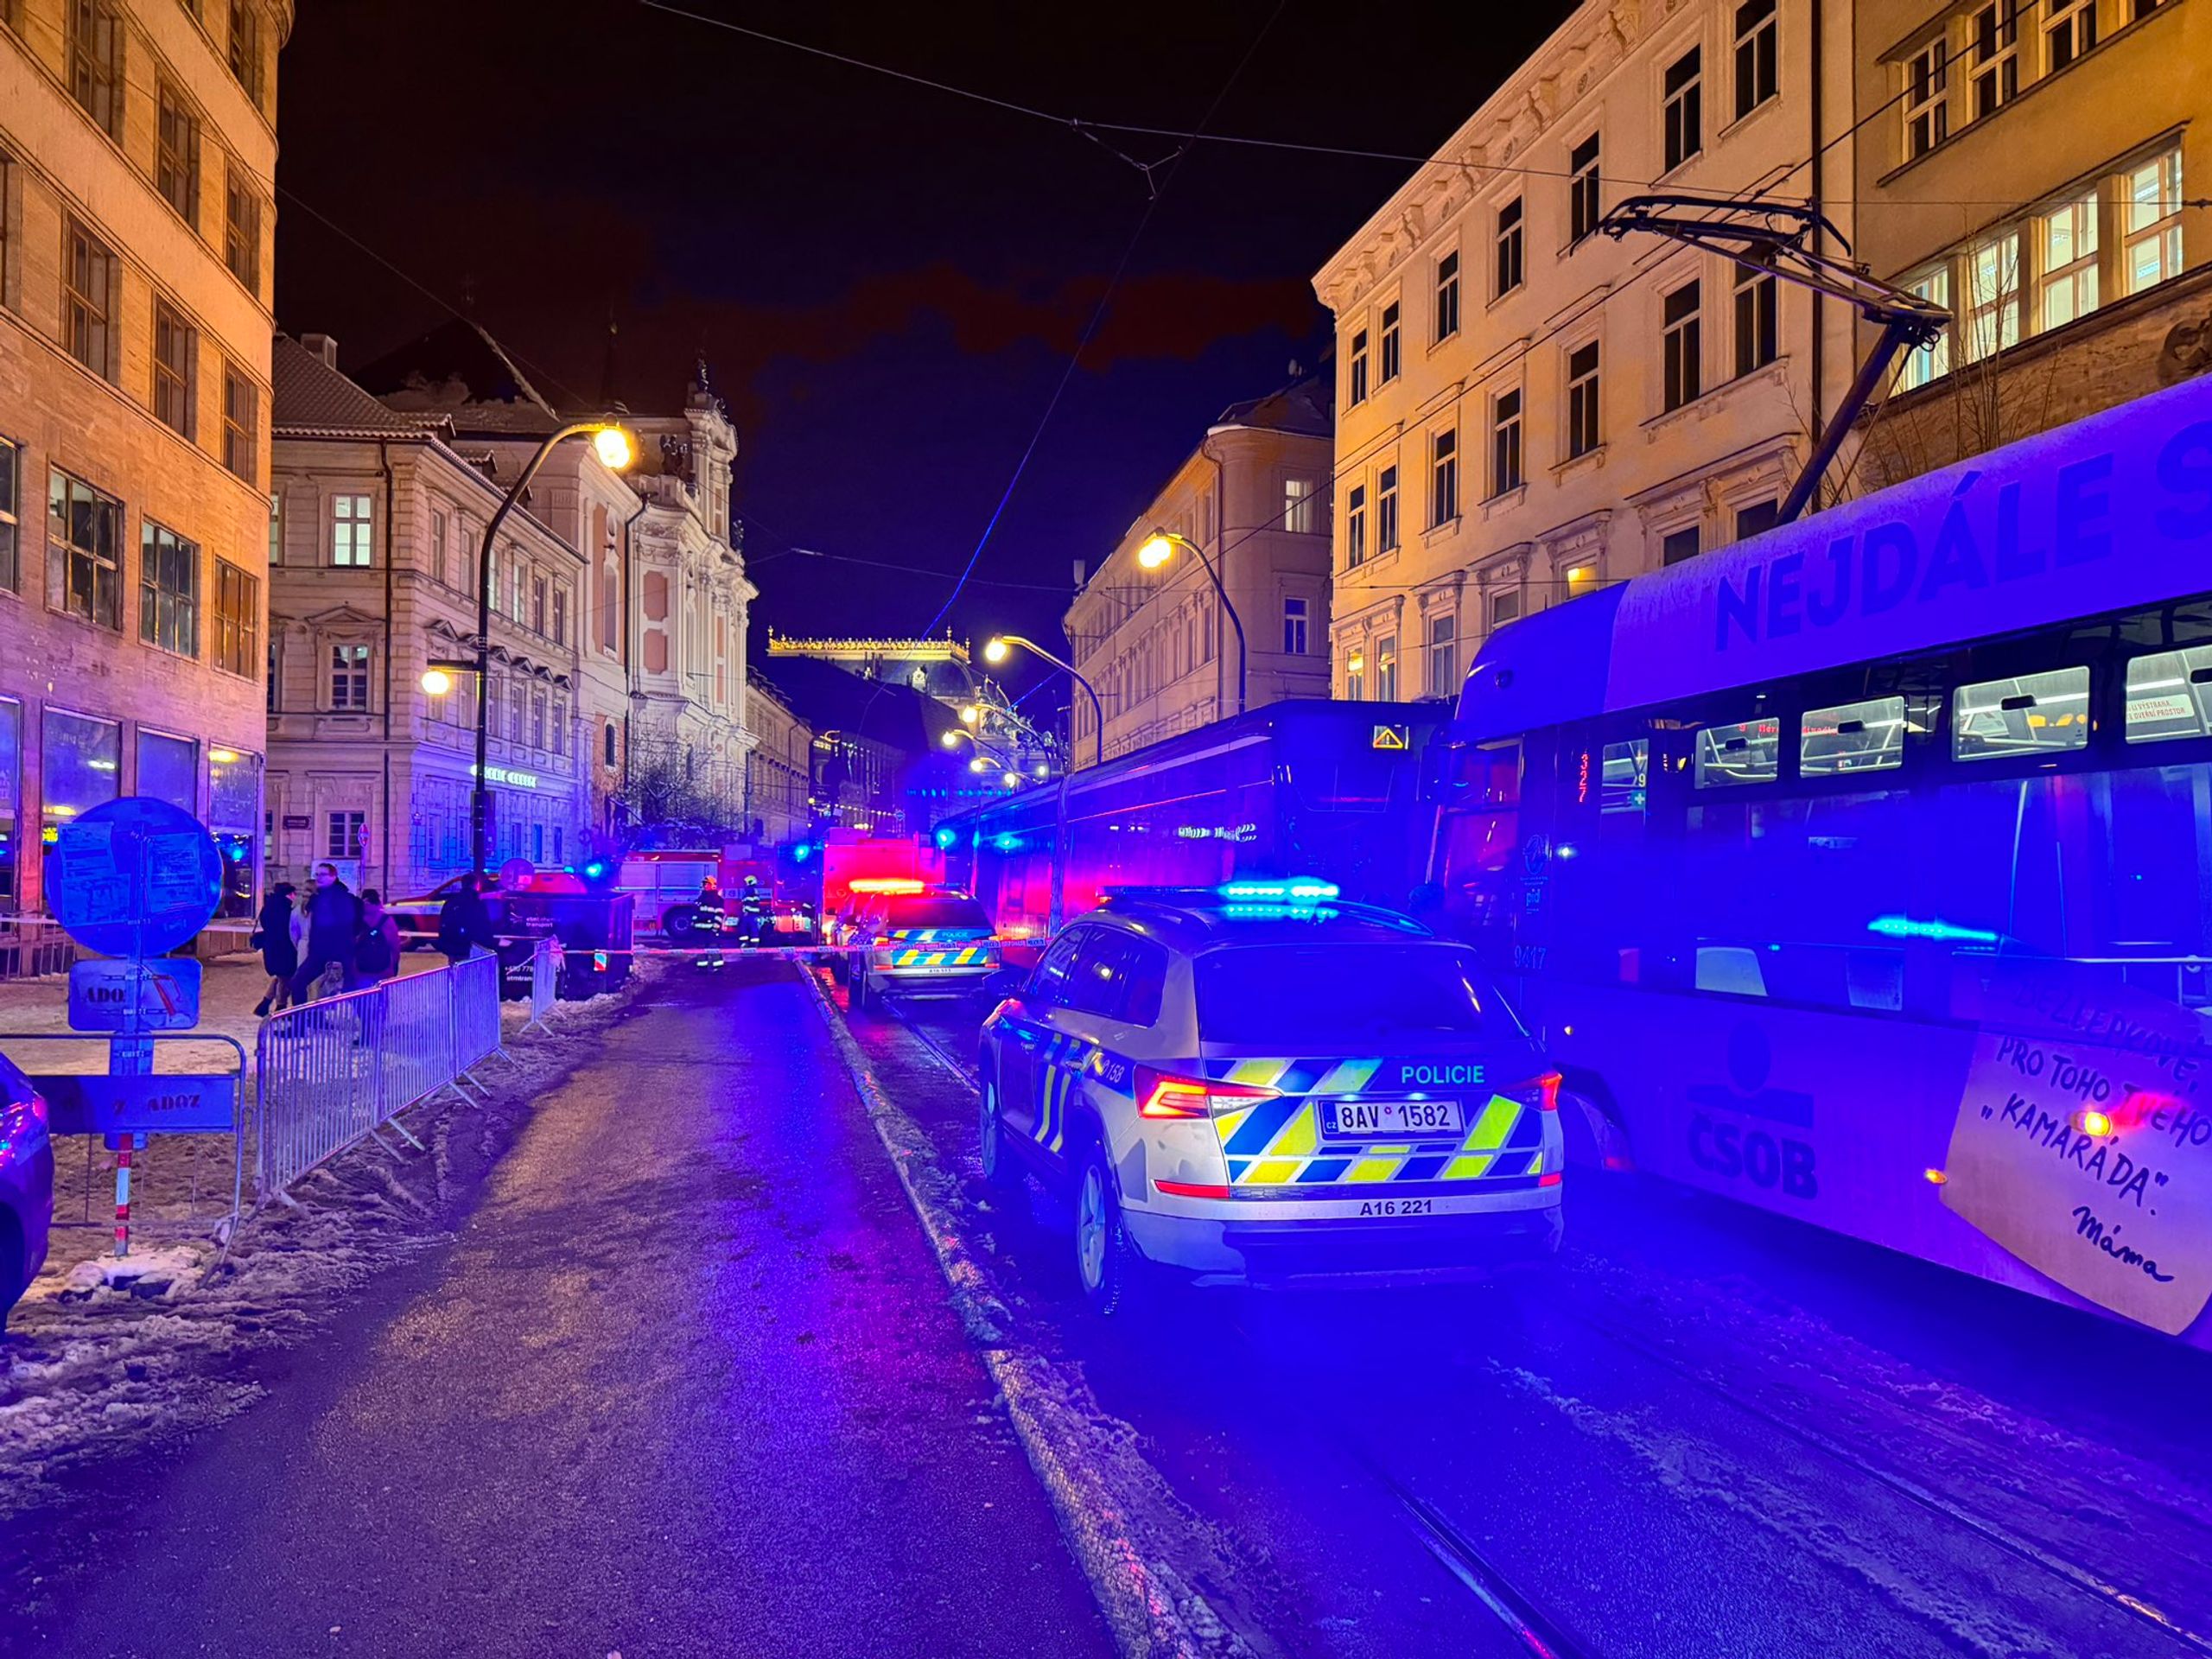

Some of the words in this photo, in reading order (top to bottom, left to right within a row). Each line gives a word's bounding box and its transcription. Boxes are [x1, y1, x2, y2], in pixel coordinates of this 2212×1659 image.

[1716, 471, 2113, 652] NEJDÁLE
[1514, 944, 1547, 969] 9417
[85, 987, 126, 1003] ADO
[1106, 1063, 1125, 1084] 158
[1401, 1065, 1485, 1084] POLICIE
[1996, 1038, 2044, 1076] PRO
[2050, 1054, 2111, 1103] TOHO
[1325, 1122, 1338, 1130] CZ
[1341, 1105, 1379, 1128] 8AV
[1398, 1104, 1451, 1128] 1582
[1359, 1201, 1395, 1217] A16
[1402, 1198, 1433, 1215] 221
